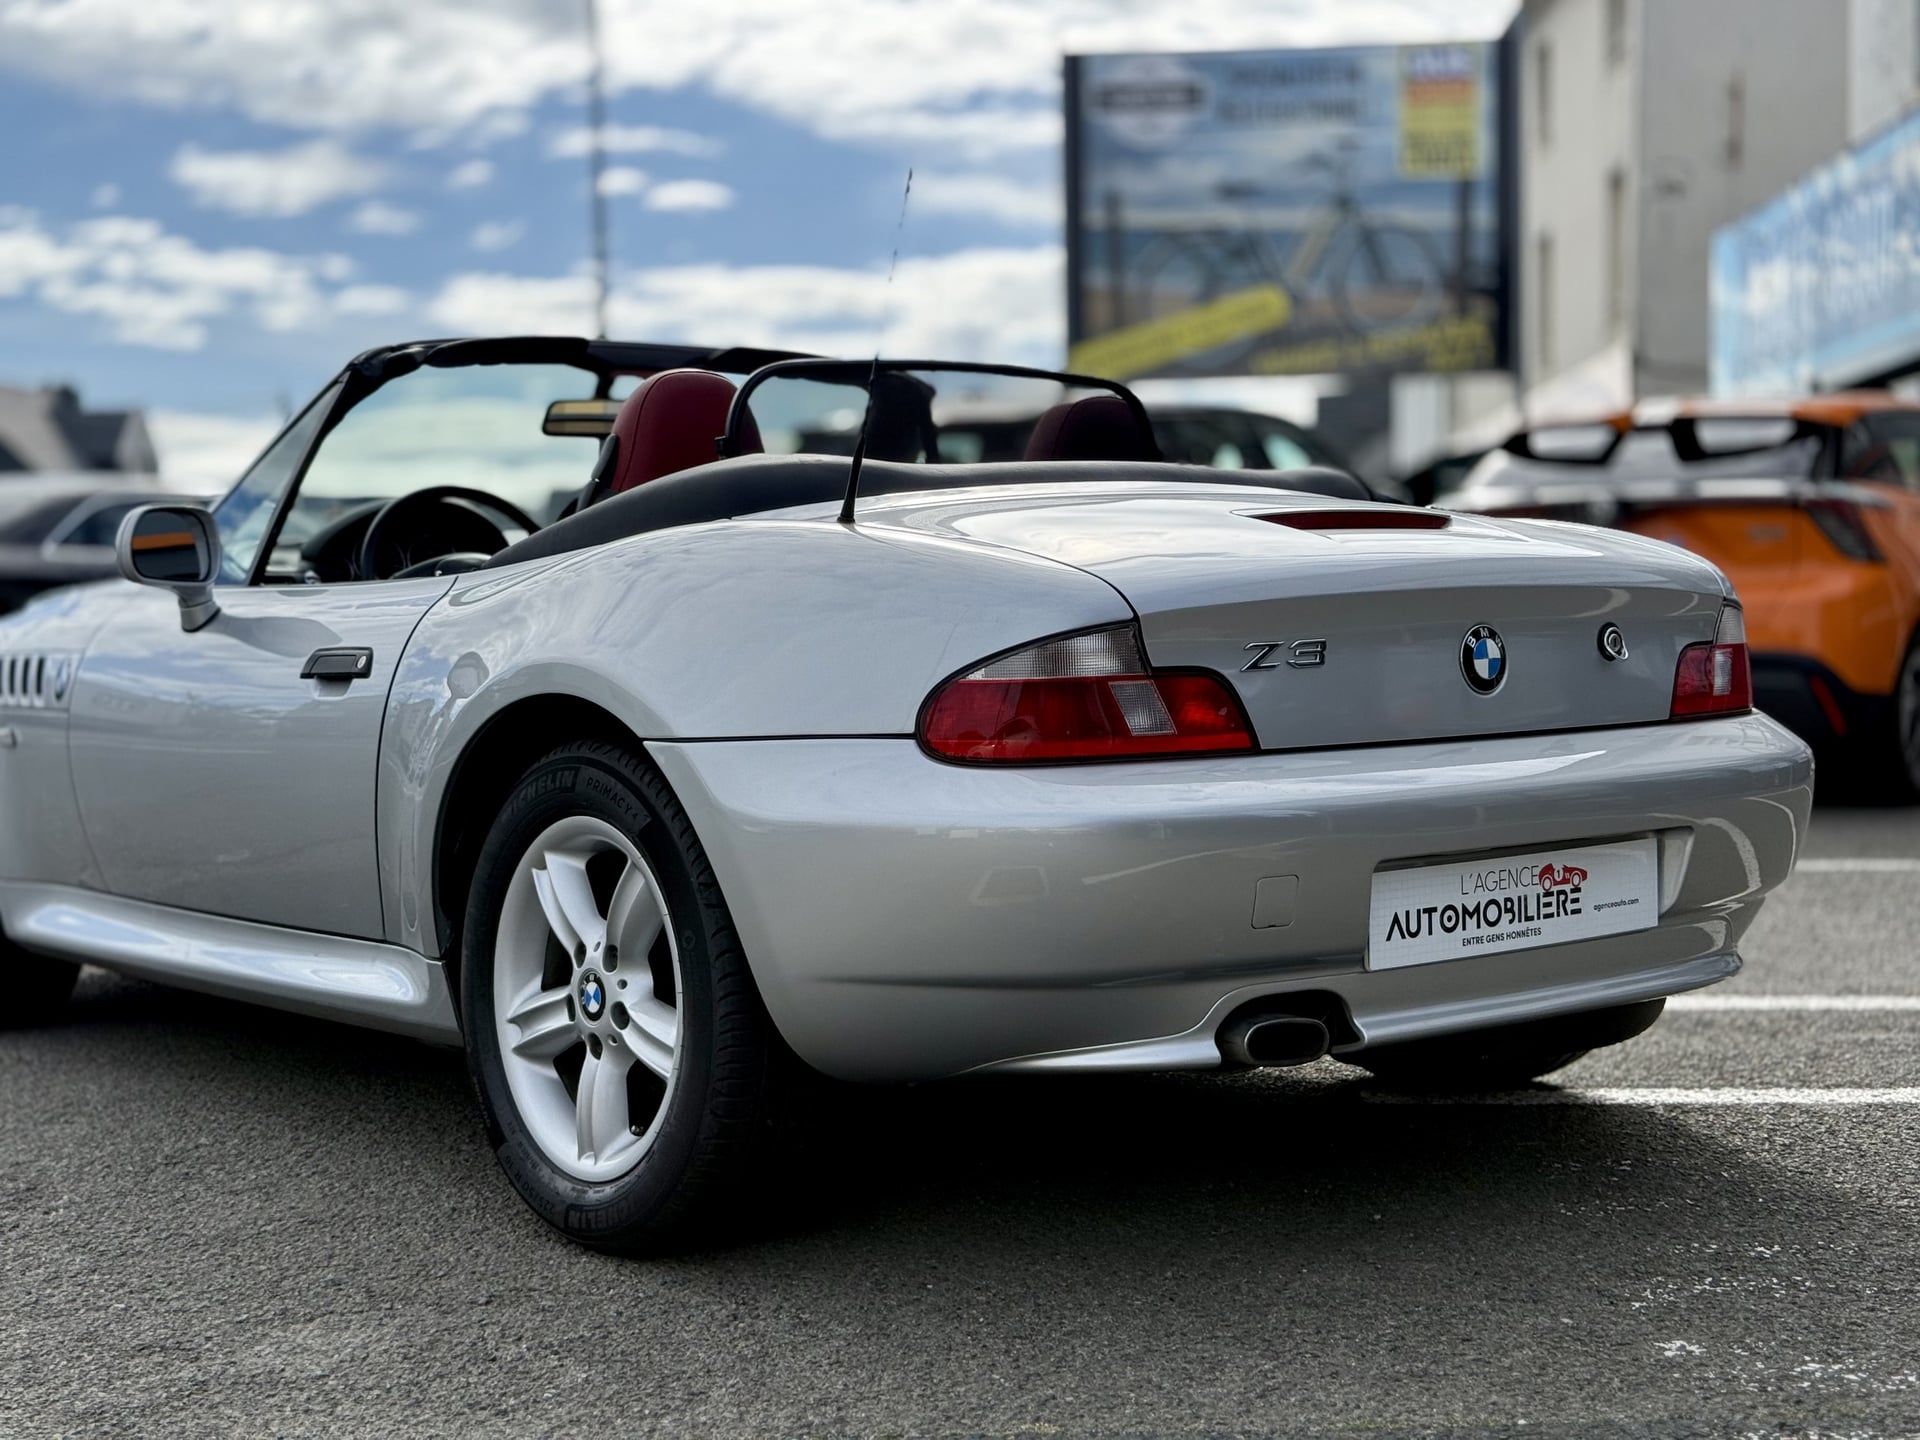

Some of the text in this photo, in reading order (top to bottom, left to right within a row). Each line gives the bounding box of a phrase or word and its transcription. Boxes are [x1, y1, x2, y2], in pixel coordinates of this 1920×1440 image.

[1240, 638, 1327, 673] Z3
[1467, 627, 1504, 658] BMW
[586, 777, 633, 814] PRIMACY
[1461, 865, 1540, 896] L'AGENCE
[1462, 926, 1542, 947] ENTRE GENS HONNÊTES
